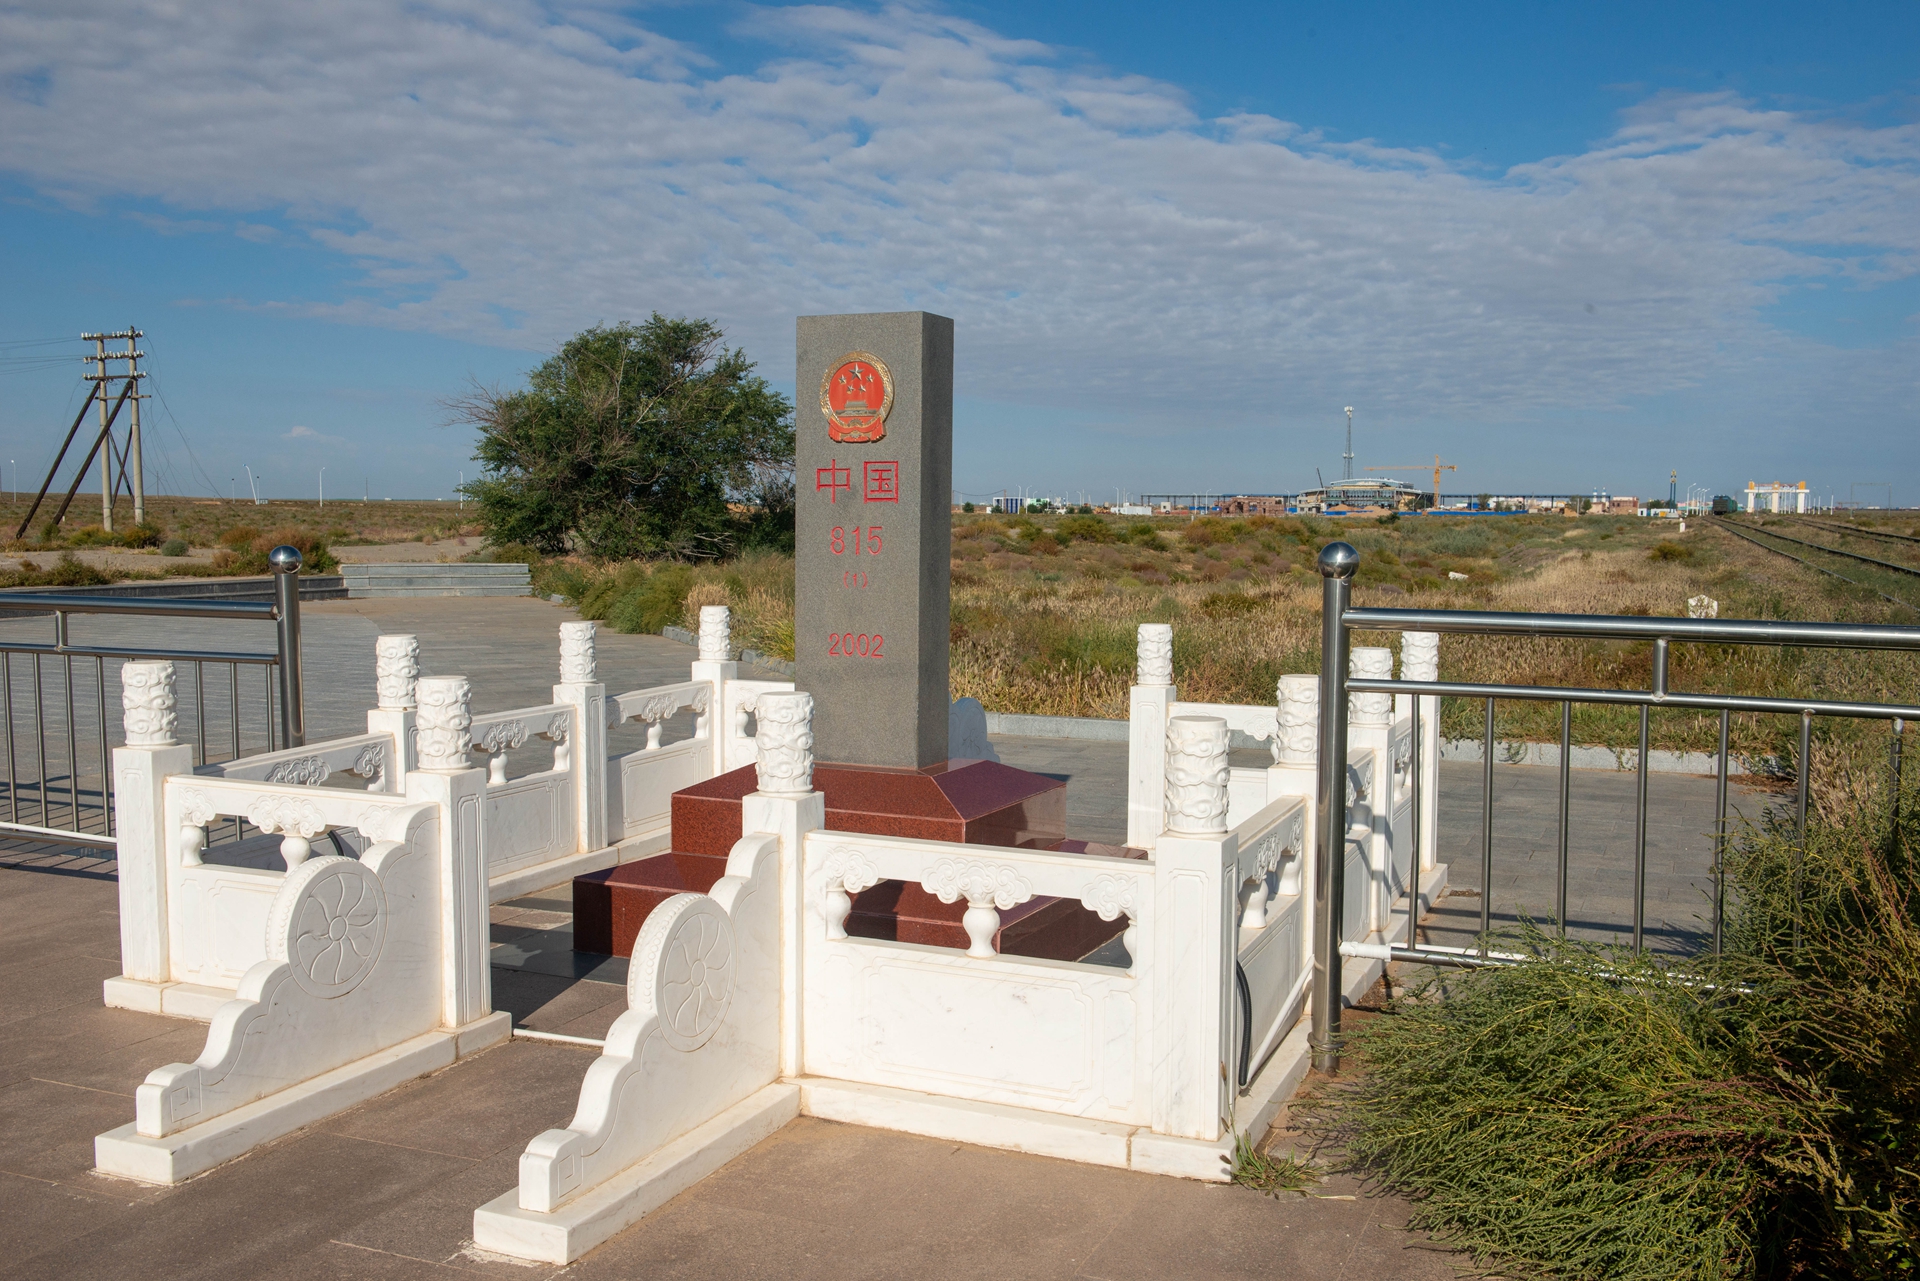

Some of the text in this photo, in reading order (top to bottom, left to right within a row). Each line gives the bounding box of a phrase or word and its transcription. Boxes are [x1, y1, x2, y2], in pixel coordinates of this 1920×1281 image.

[816, 459, 899, 504] 中国
[830, 526, 883, 556] 815
[843, 571, 868, 589] (1)
[828, 633, 884, 658] 2002
